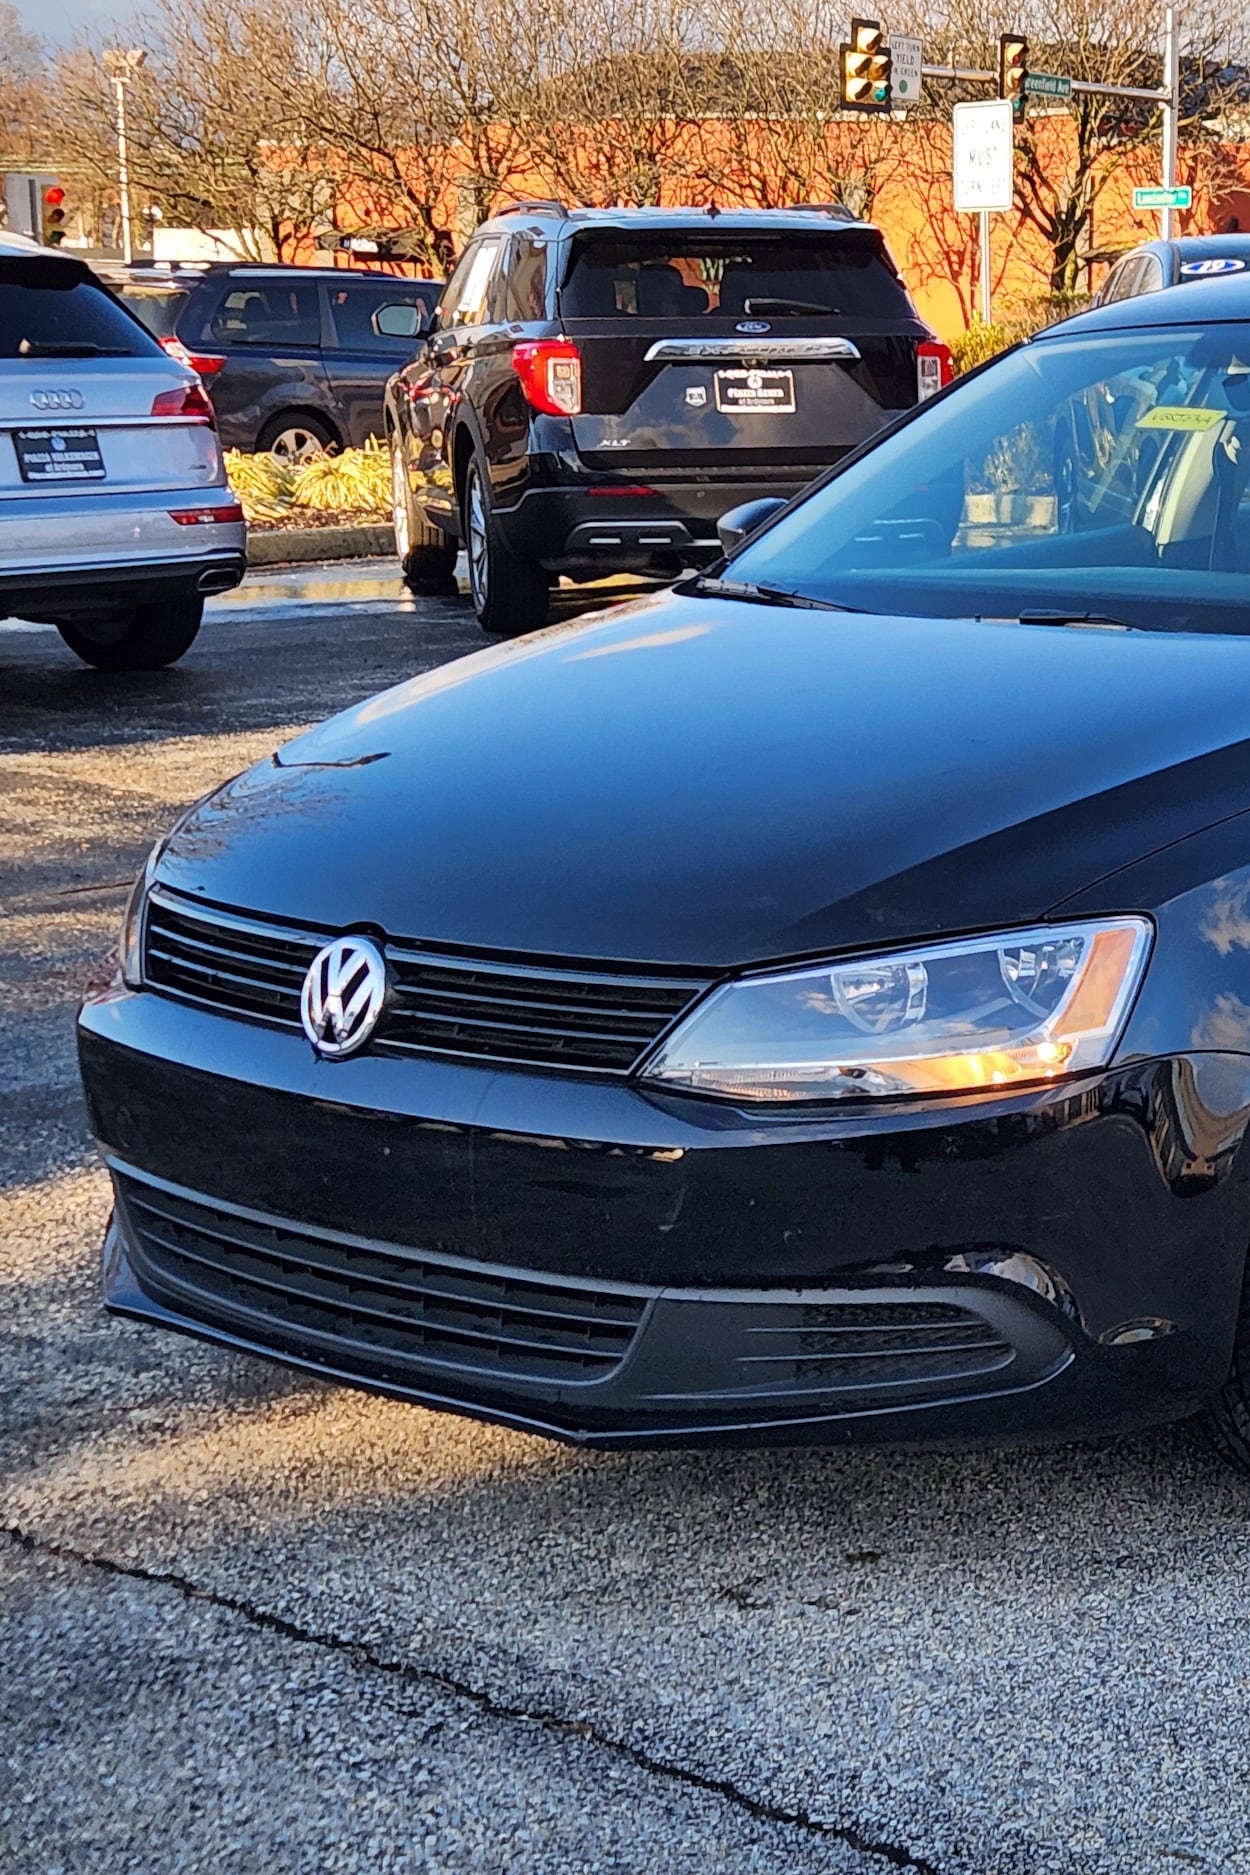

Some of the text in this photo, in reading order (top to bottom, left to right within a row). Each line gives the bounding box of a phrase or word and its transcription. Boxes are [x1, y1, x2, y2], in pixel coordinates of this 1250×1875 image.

[892, 41, 920, 52] LEFT TURN
[896, 54, 915, 65] YIELD
[900, 69, 918, 77] GREEN
[599, 439, 631, 447] XLT
